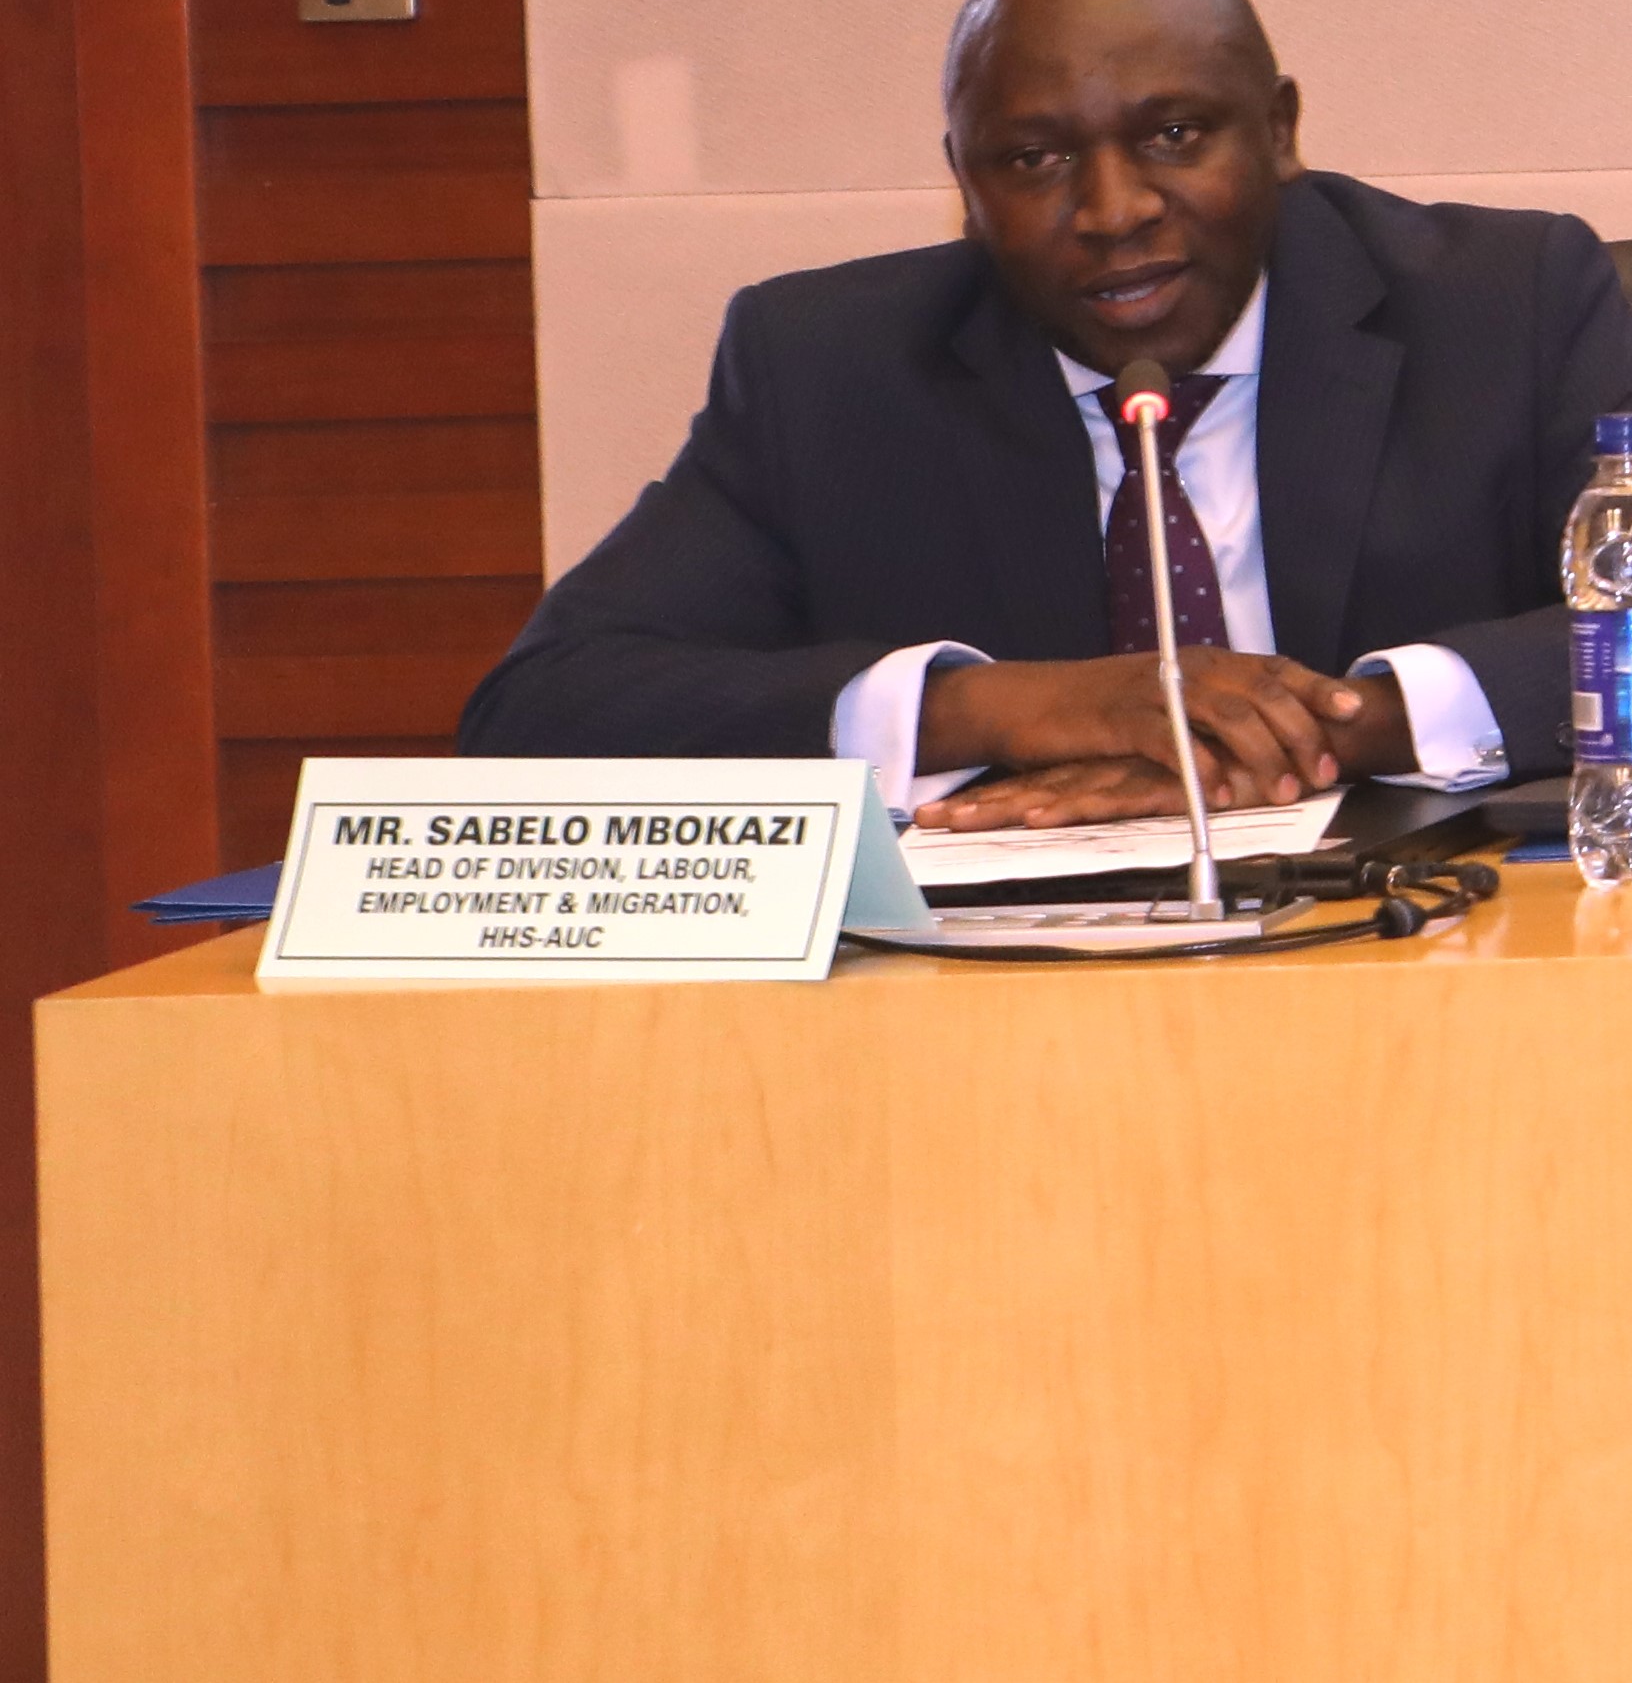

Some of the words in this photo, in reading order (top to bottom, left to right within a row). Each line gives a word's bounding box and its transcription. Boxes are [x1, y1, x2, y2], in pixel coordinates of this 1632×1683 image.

[334, 816, 410, 845] MR.
[427, 816, 589, 845] SABELO
[605, 816, 806, 846] MBOKAZI
[367, 858, 443, 879] HEAD
[453, 857, 490, 879] OF
[496, 857, 625, 882] DIVISION,
[637, 858, 755, 882] LABOUR,
[358, 892, 550, 914] EMPLOYMENT
[557, 892, 576, 914] &
[587, 892, 747, 916] MIGRATION,
[479, 926, 604, 948] HHS-AUC
